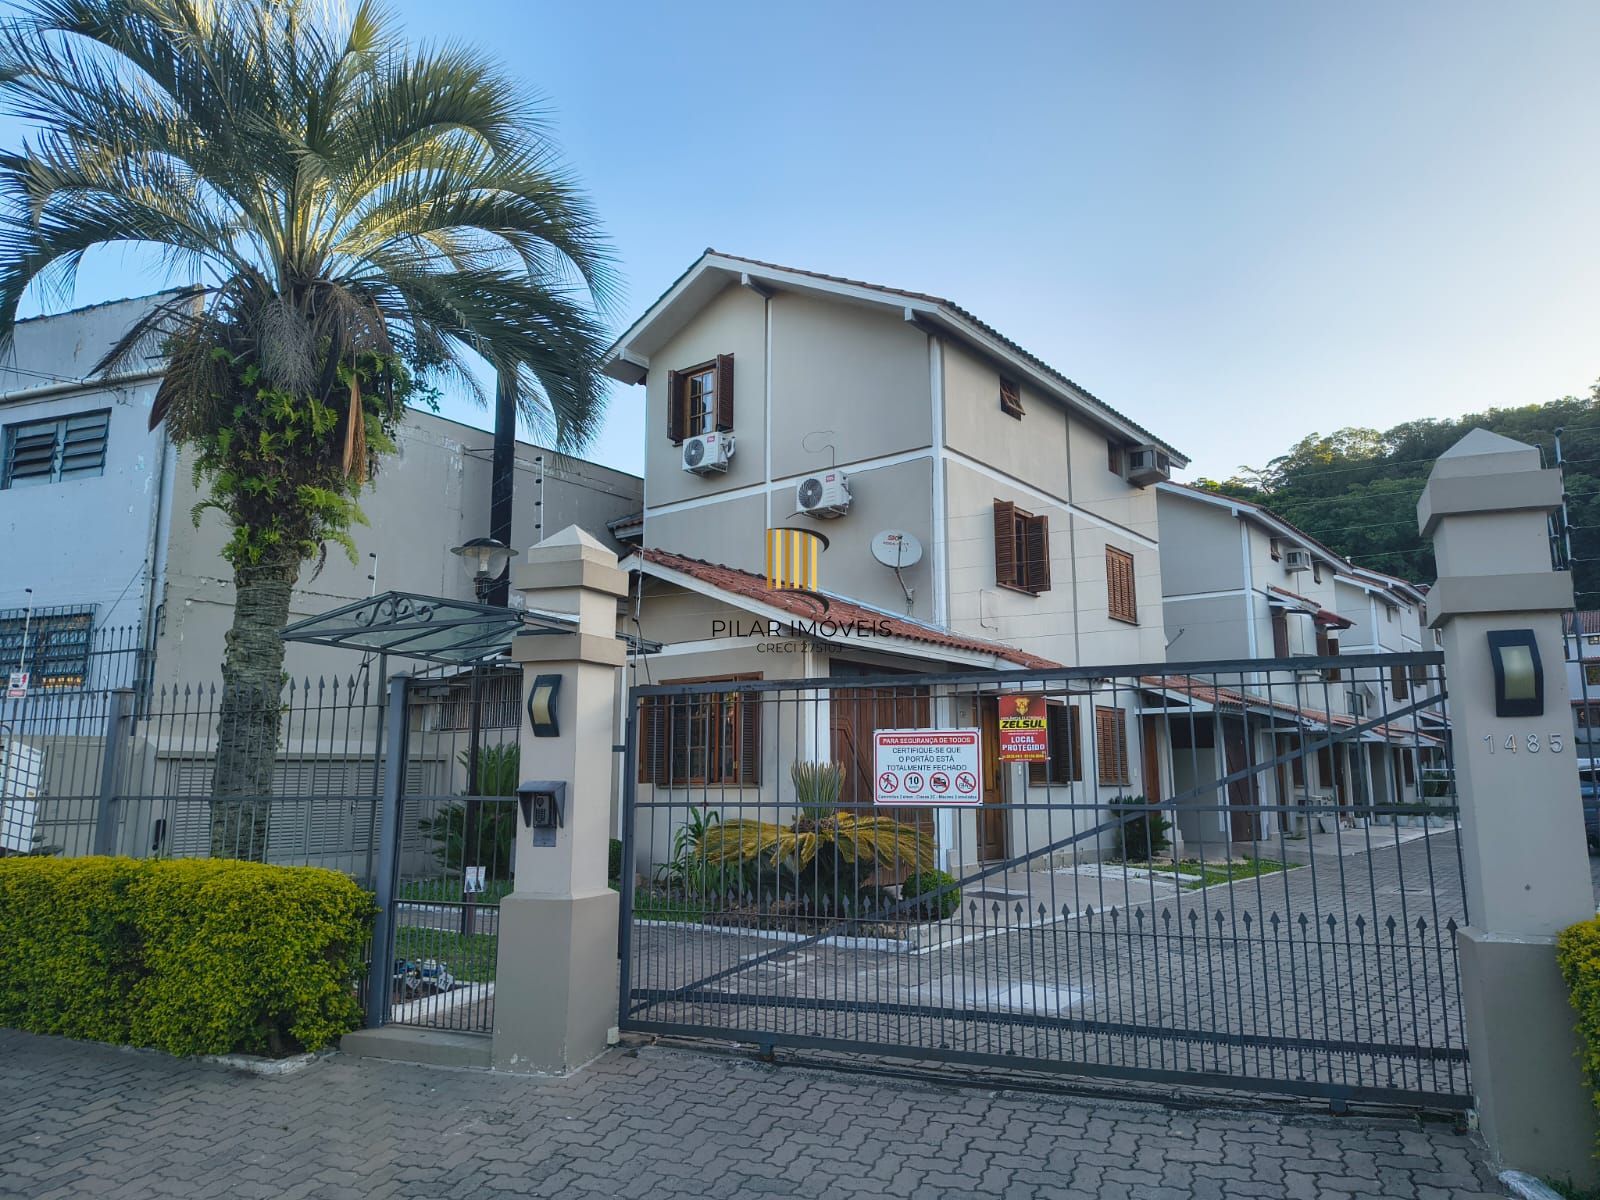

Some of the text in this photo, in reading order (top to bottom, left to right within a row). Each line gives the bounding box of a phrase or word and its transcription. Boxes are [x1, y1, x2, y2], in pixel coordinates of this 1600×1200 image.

[1002, 720, 1045, 729] ZELSUL
[900, 737, 938, 745] SEGURANÇA
[1010, 735, 1035, 743] LOCAL
[1484, 733, 1564, 753] 1485
[906, 755, 934, 763] PORTÃO
[908, 776, 920, 785] 10
